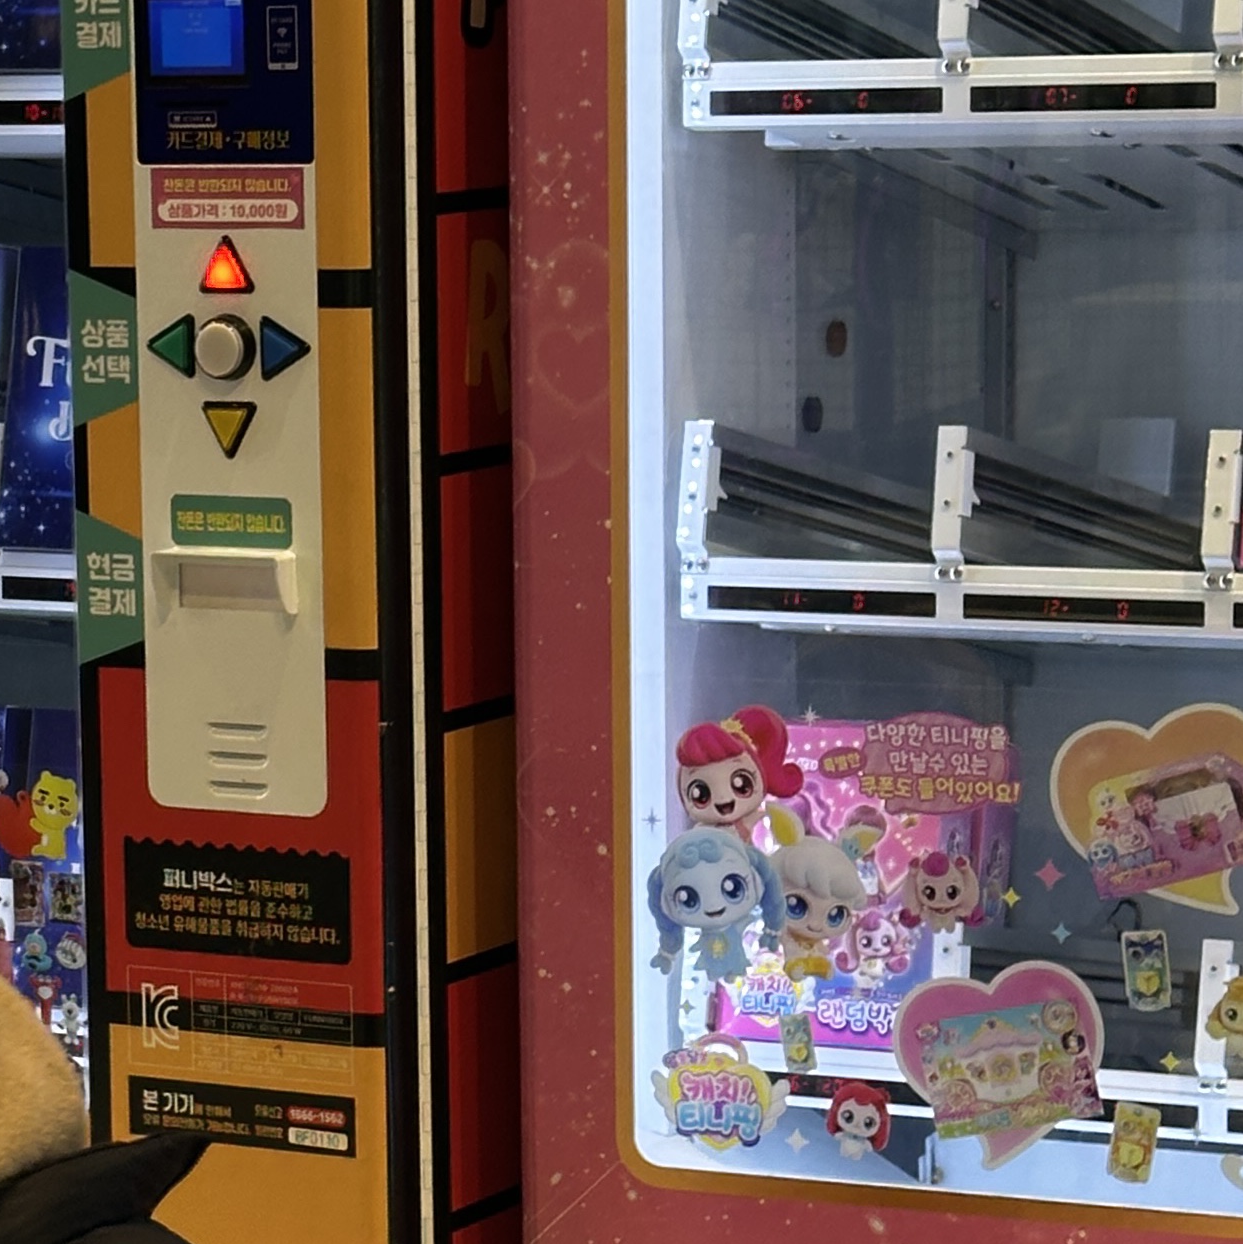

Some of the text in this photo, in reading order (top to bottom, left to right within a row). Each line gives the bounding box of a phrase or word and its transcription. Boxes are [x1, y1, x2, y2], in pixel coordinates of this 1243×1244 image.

[76, 22, 122, 49] 결제
[81, 319, 130, 349] 상품
[82, 354, 131, 384] 선택
[87, 552, 135, 582] 현금
[89, 587, 136, 617] 결제
[867, 723, 1007, 750] 다양한 티니핑을
[889, 752, 988, 775] 만날수 있는
[860, 775, 1021, 804] 쿠폰도 들어있어요!
[816, 998, 898, 1034] 랜덤박
[143, 1089, 159, 1112] 본
